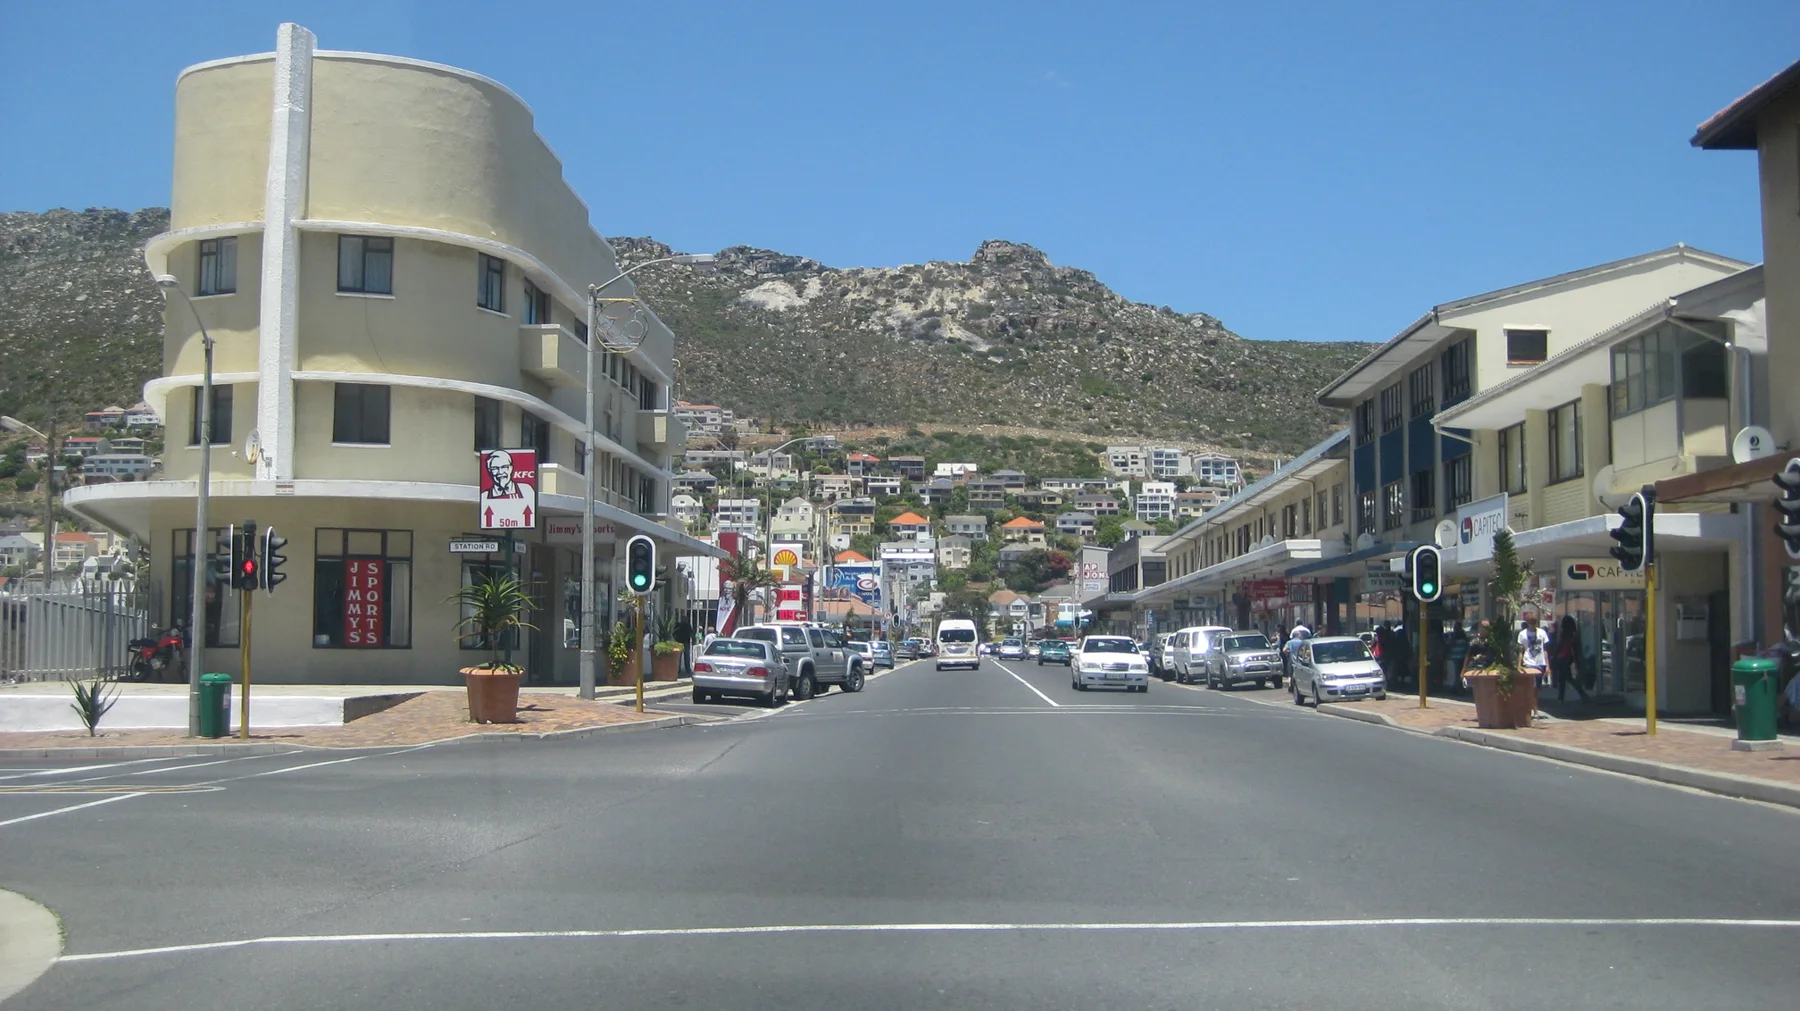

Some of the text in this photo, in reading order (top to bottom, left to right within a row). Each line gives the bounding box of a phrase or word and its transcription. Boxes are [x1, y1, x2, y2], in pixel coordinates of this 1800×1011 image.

[513, 470, 535, 479] KFC
[499, 518, 518, 527] 50m
[1473, 513, 1502, 537] CAPITEC
[548, 523, 582, 535] Jimmy's
[454, 542, 483, 550] STATION
[347, 562, 362, 643] JIMMY'S
[366, 563, 379, 644] SPORTS
